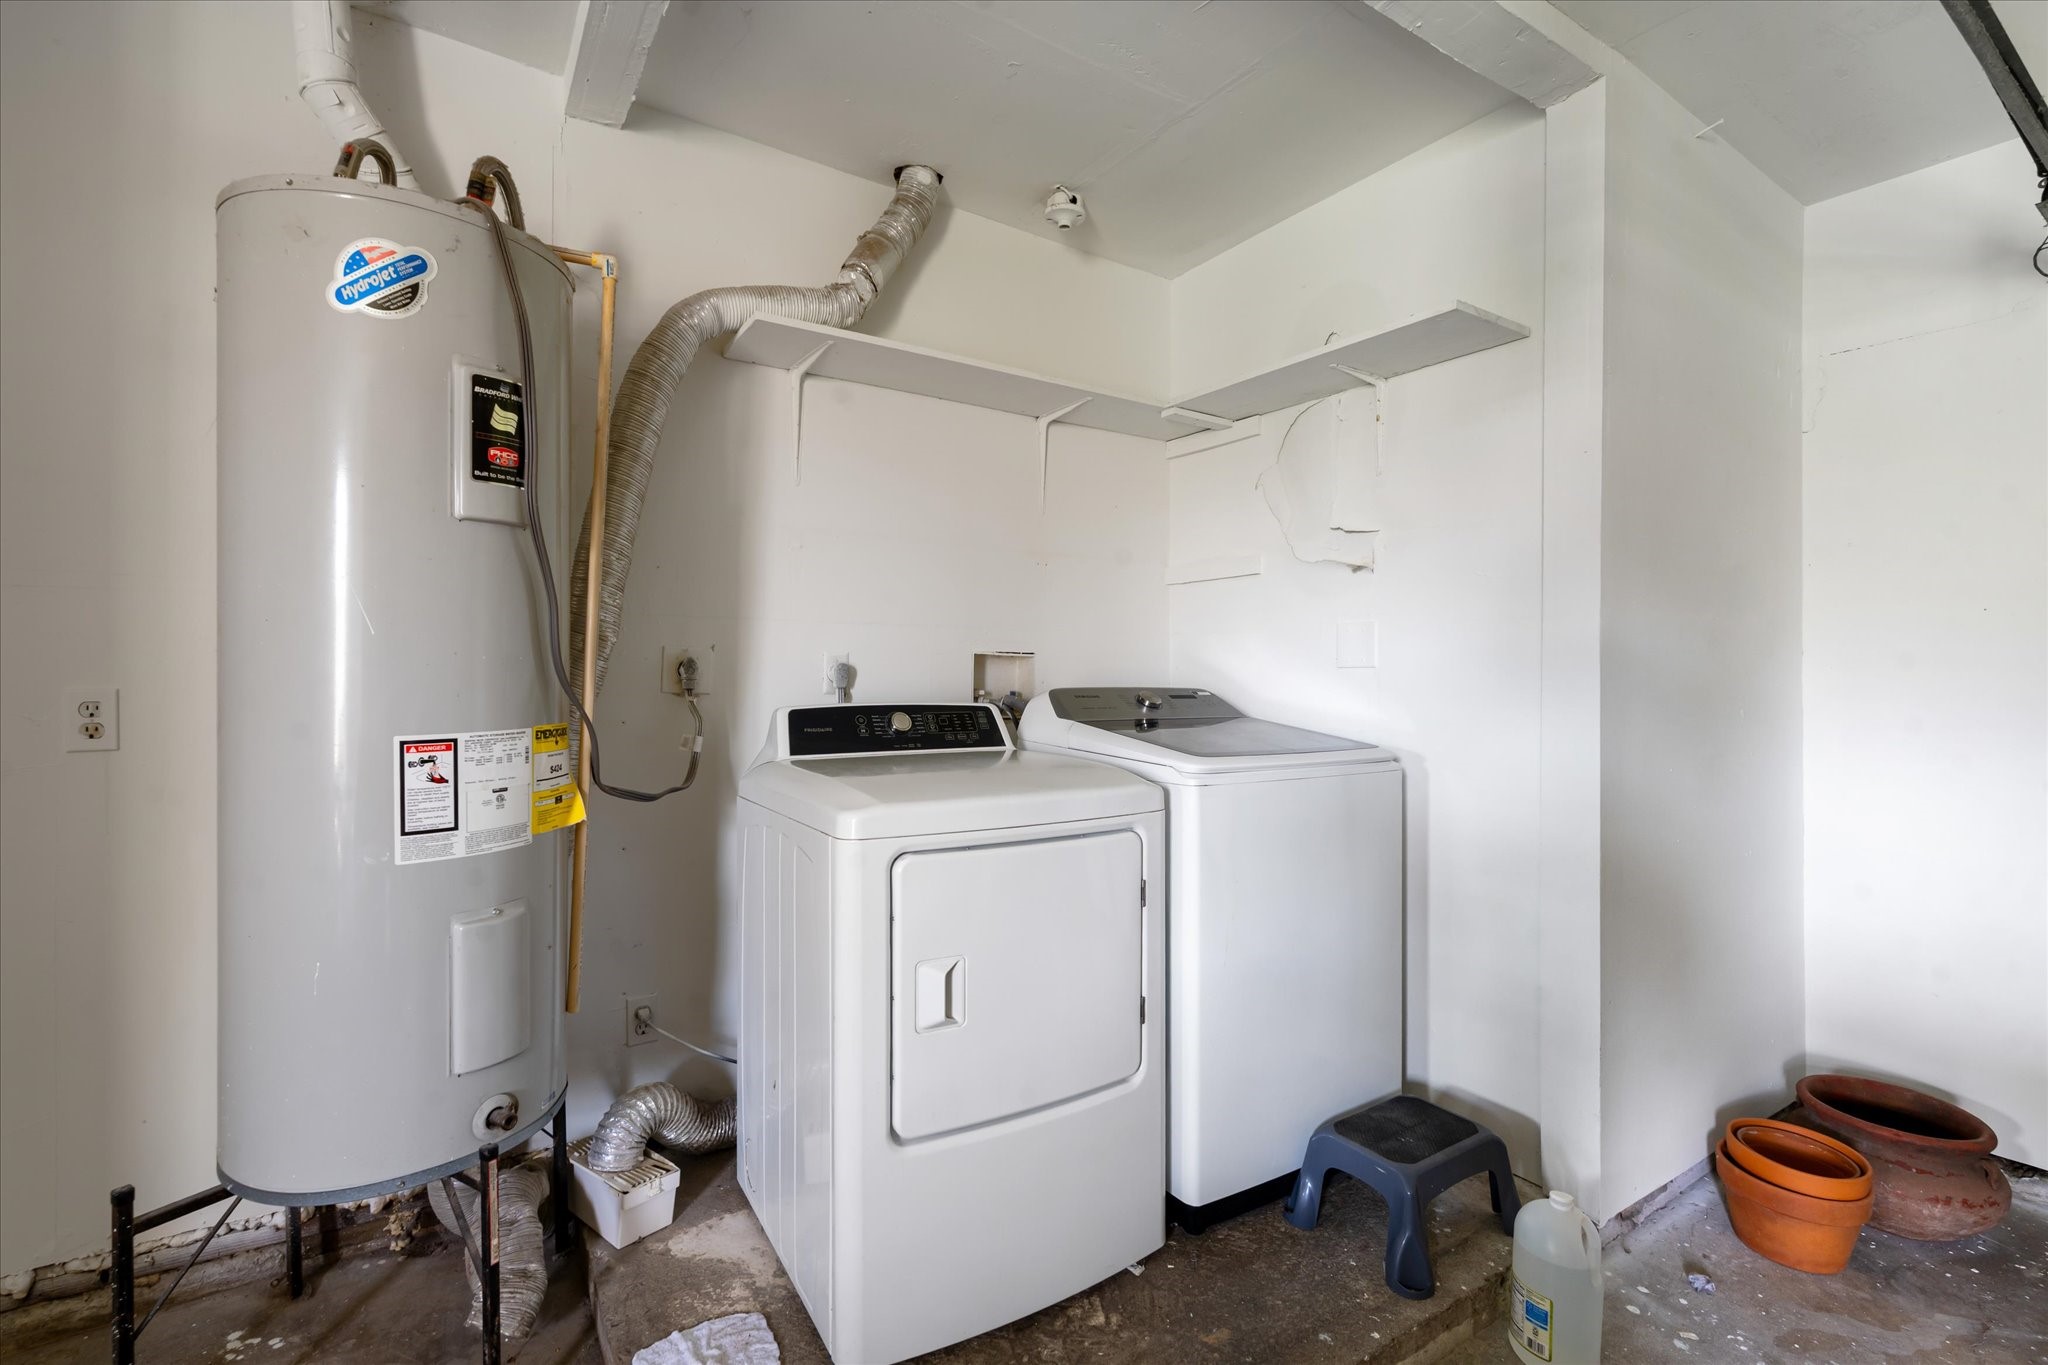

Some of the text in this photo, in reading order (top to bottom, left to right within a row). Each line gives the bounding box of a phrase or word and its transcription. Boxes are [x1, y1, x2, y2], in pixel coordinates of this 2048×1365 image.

[341, 265, 397, 300] Hydrojet
[474, 385, 510, 399] BRADFORD
[490, 449, 518, 461] PHCC
[418, 744, 447, 752] DANGER
